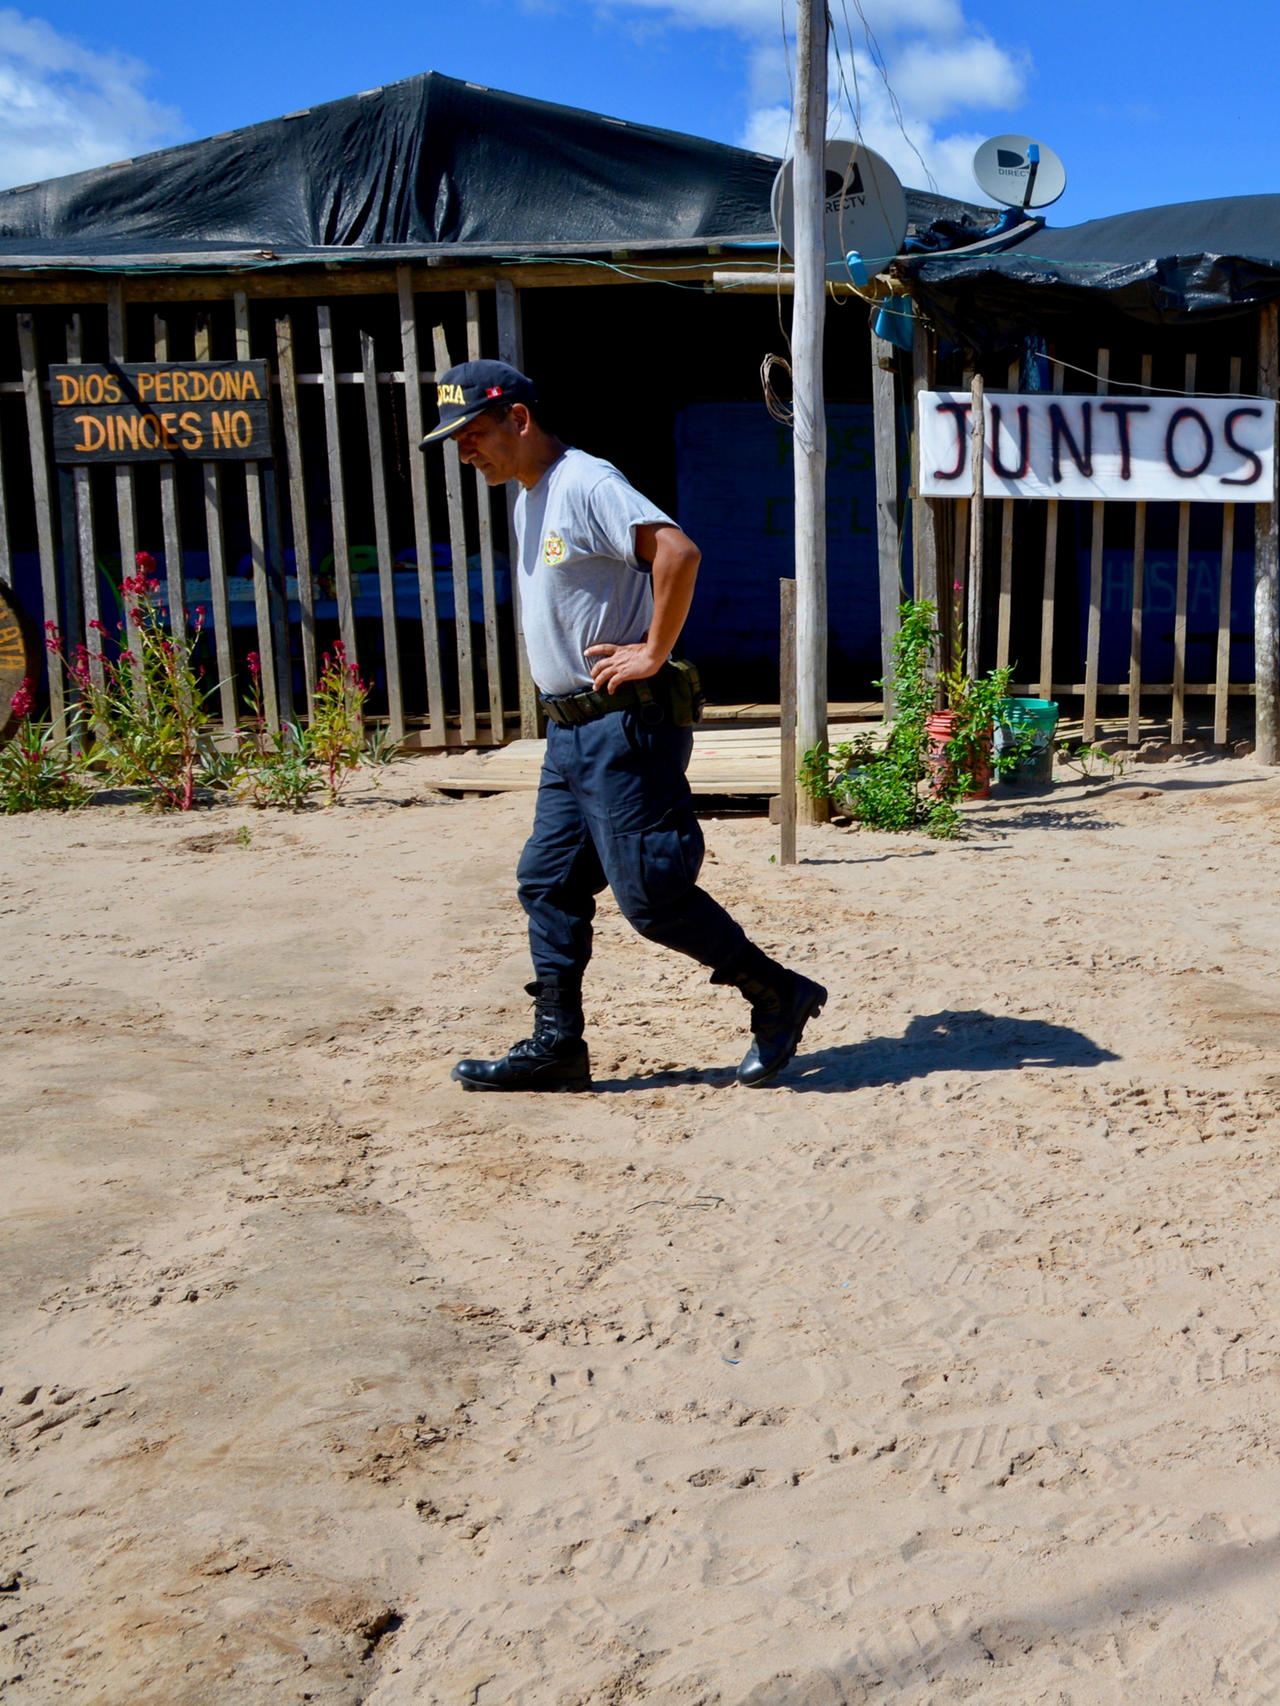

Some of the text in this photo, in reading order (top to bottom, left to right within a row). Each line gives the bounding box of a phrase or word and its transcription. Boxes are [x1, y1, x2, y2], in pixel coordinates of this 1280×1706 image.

[998, 168, 1030, 178] DIREC
[825, 195, 867, 214] RECTV
[56, 370, 261, 406] DIOS PERDONA
[74, 410, 253, 452] DINOES NO
[933, 401, 1264, 487] JUNTOS
